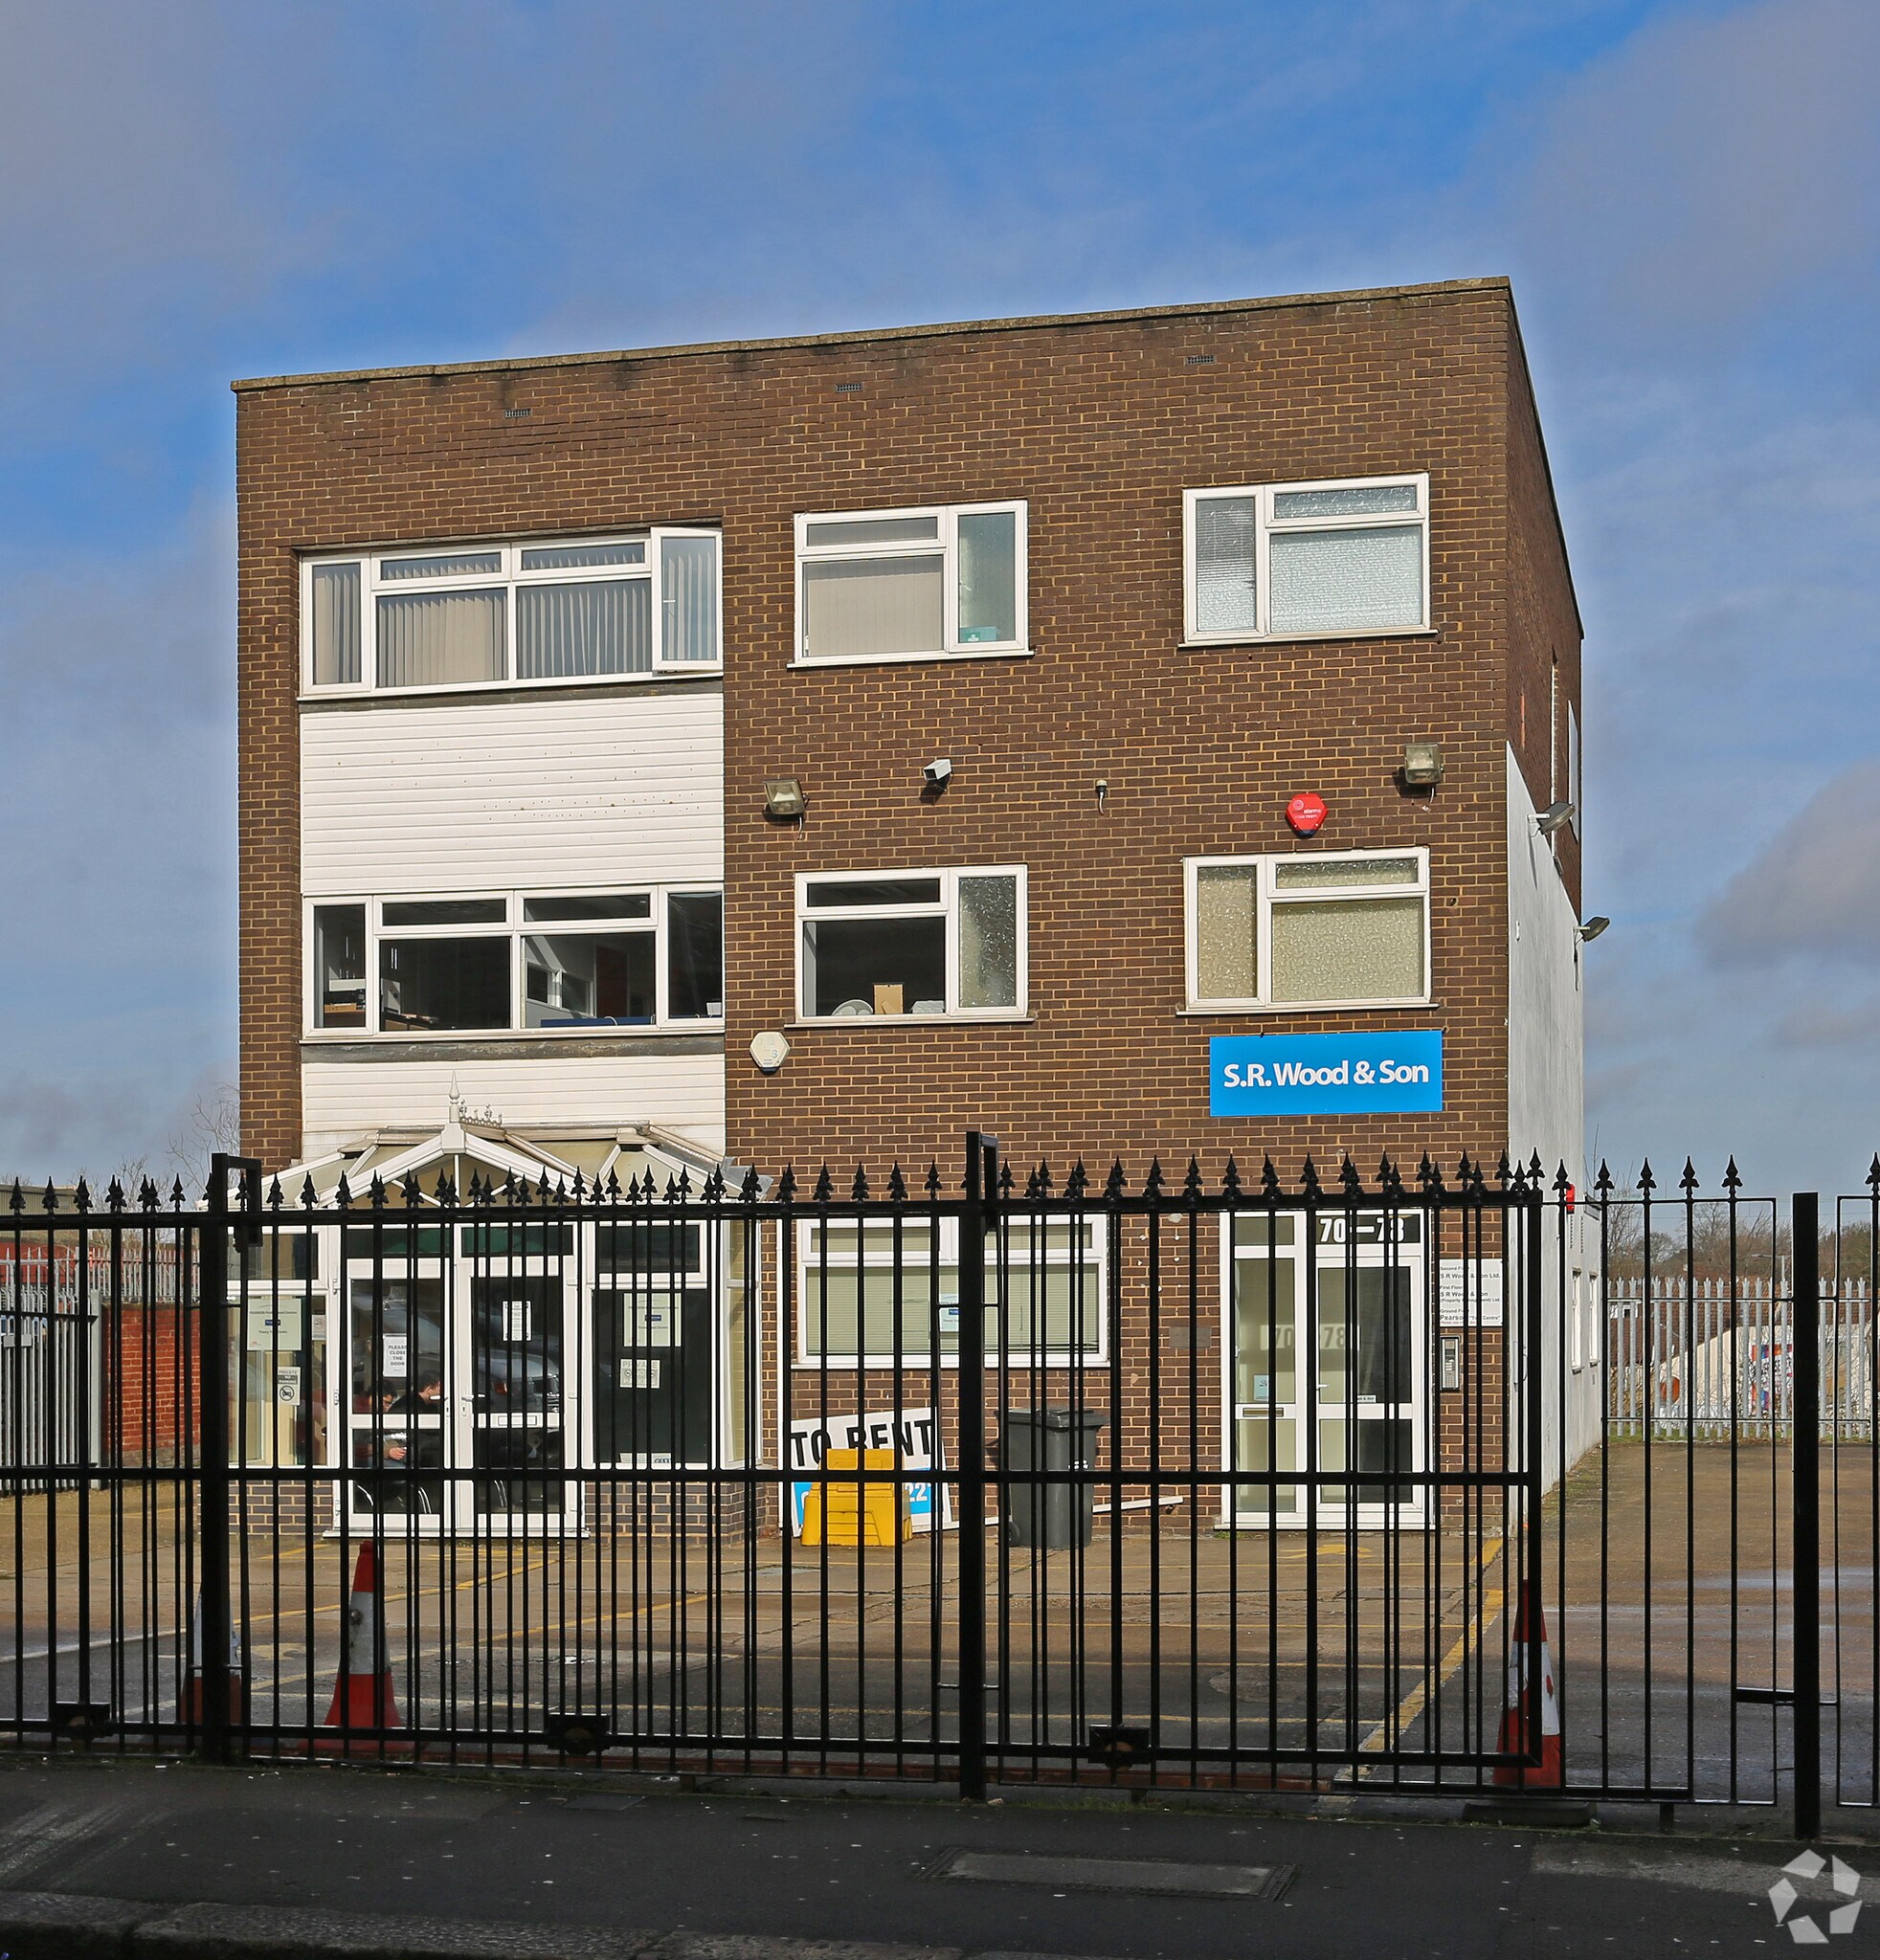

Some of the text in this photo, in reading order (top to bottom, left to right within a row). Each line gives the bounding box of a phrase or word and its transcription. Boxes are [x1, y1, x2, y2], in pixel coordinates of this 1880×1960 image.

[1223, 1059, 1429, 1088] S.R. Wood & Son
